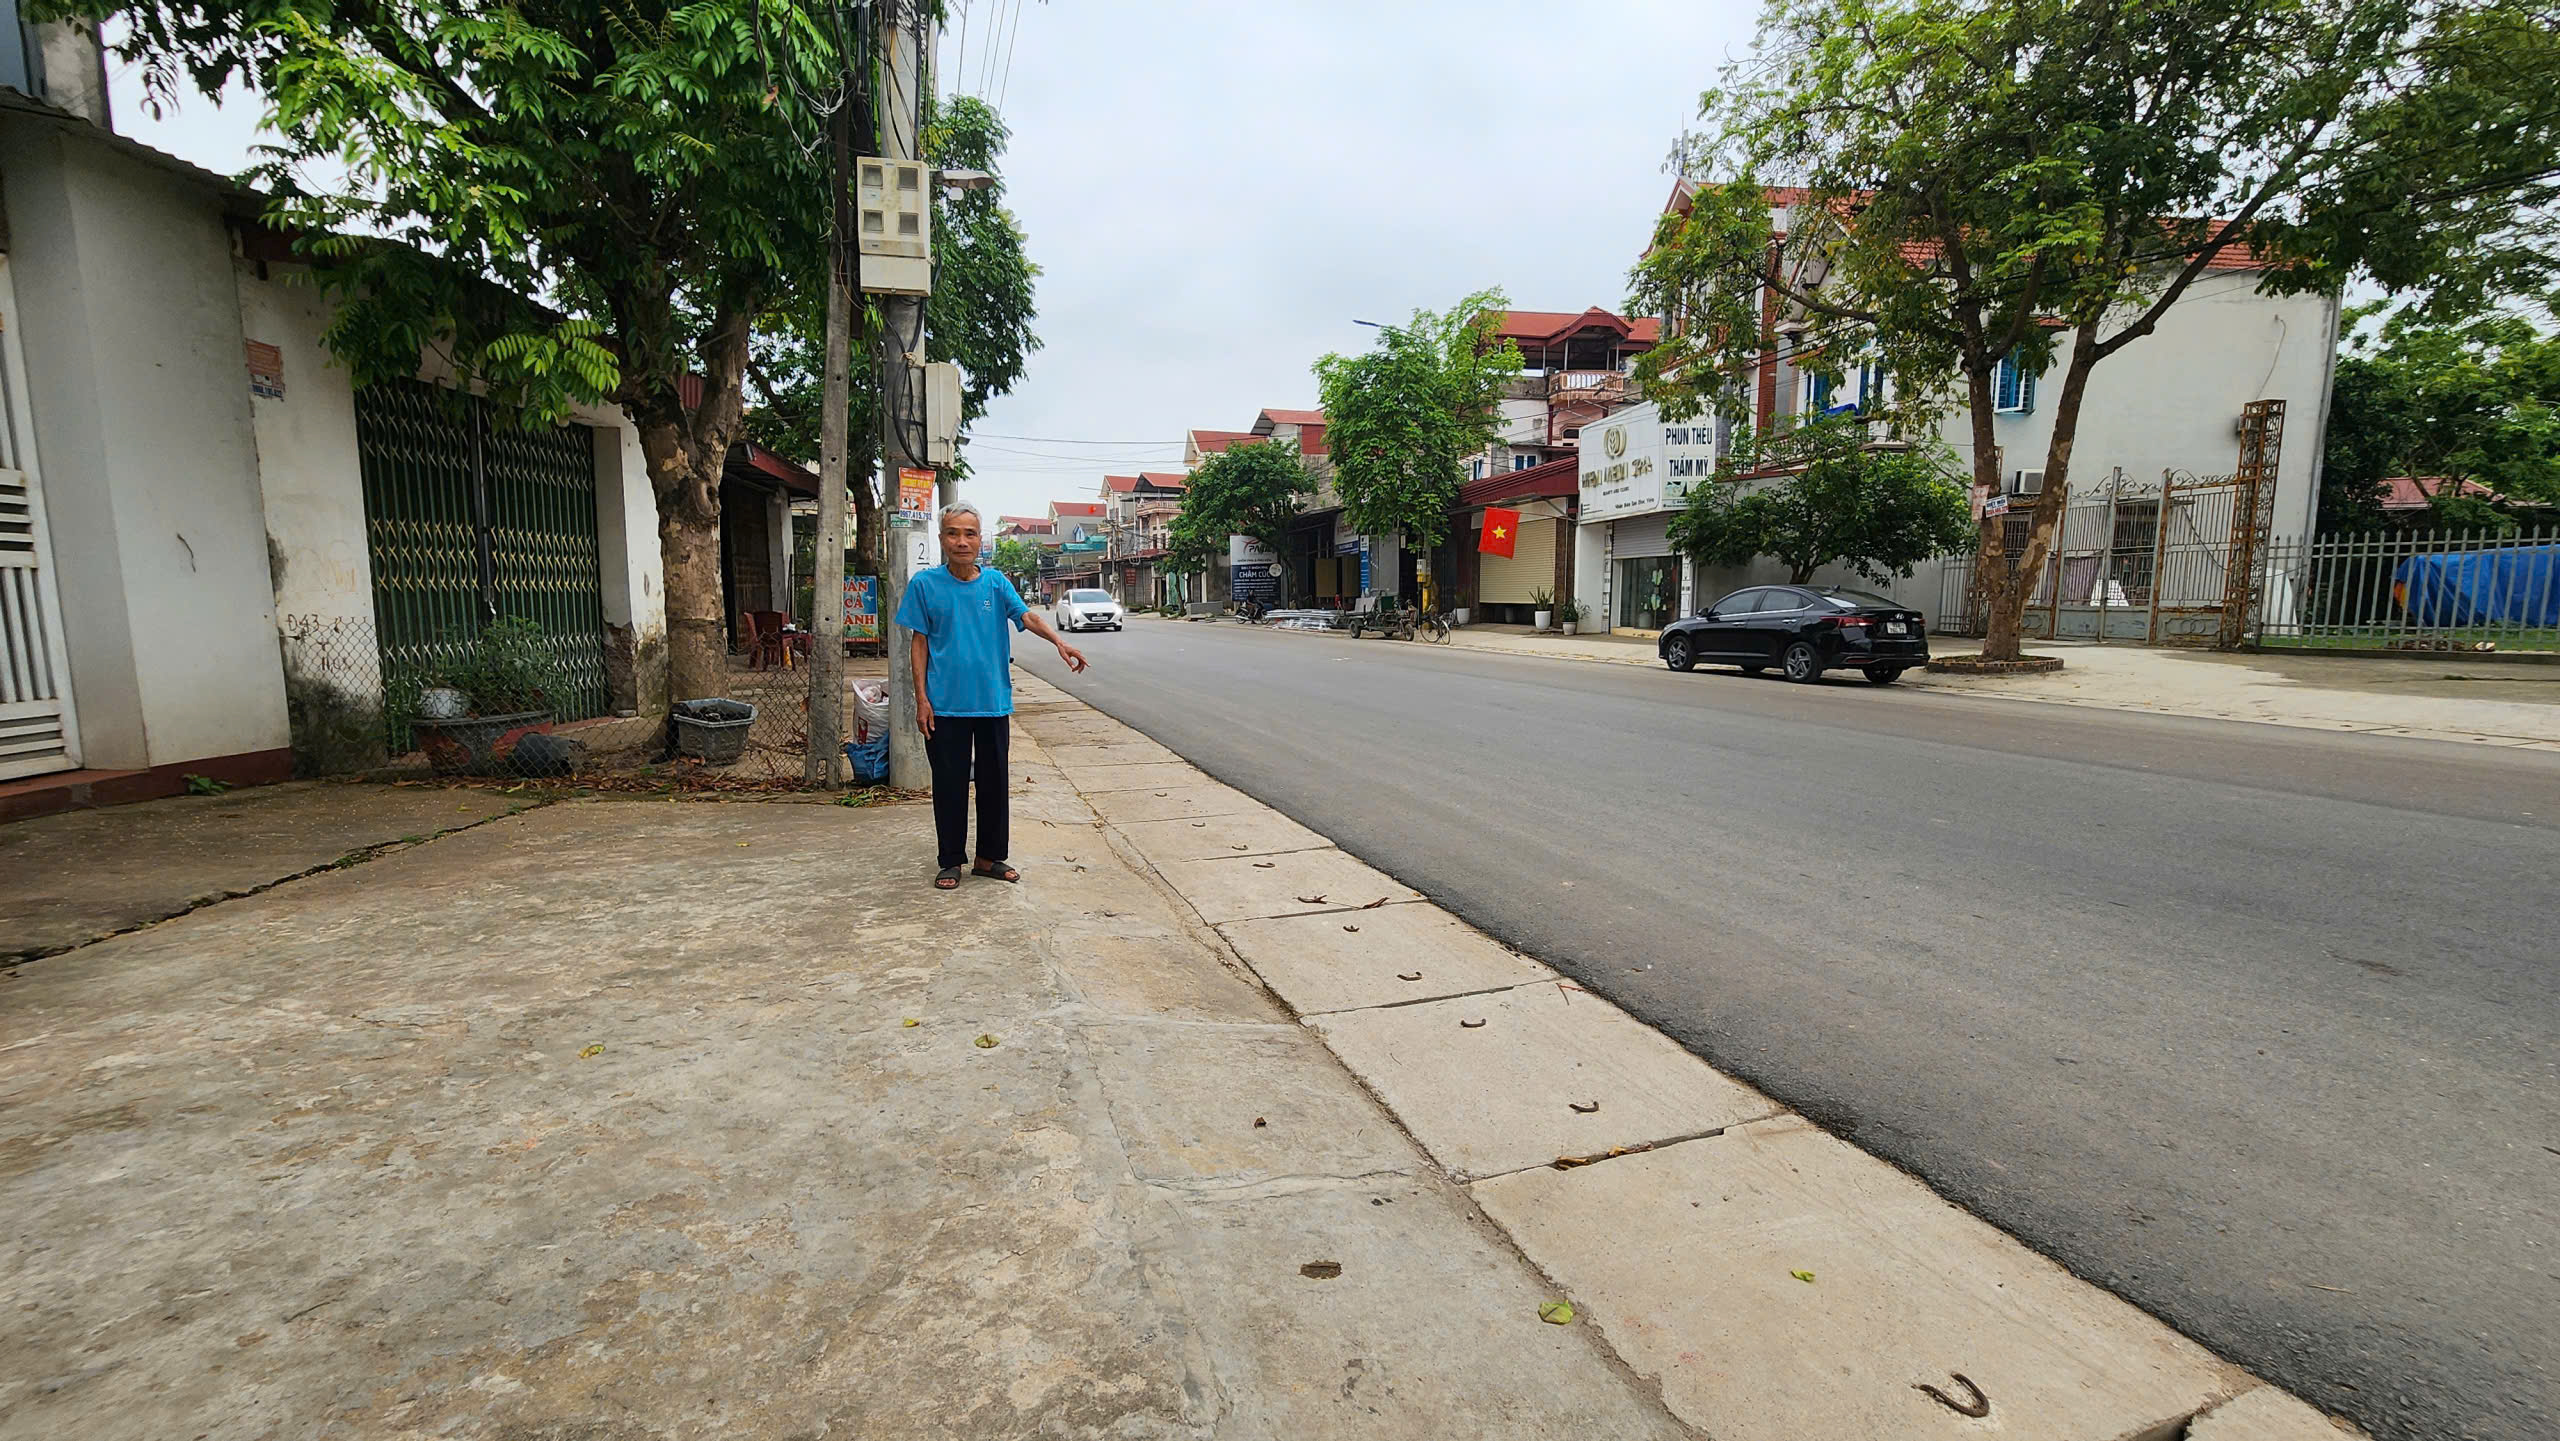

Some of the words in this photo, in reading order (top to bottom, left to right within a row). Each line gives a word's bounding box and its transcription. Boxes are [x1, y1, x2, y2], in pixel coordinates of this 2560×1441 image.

[1665, 427, 1689, 445] PHUN
[1692, 424, 1712, 445] THÊU
[1669, 452, 1693, 477] THẨM
[1695, 456, 1709, 477] MỸ
[917, 542, 925, 560] 2
